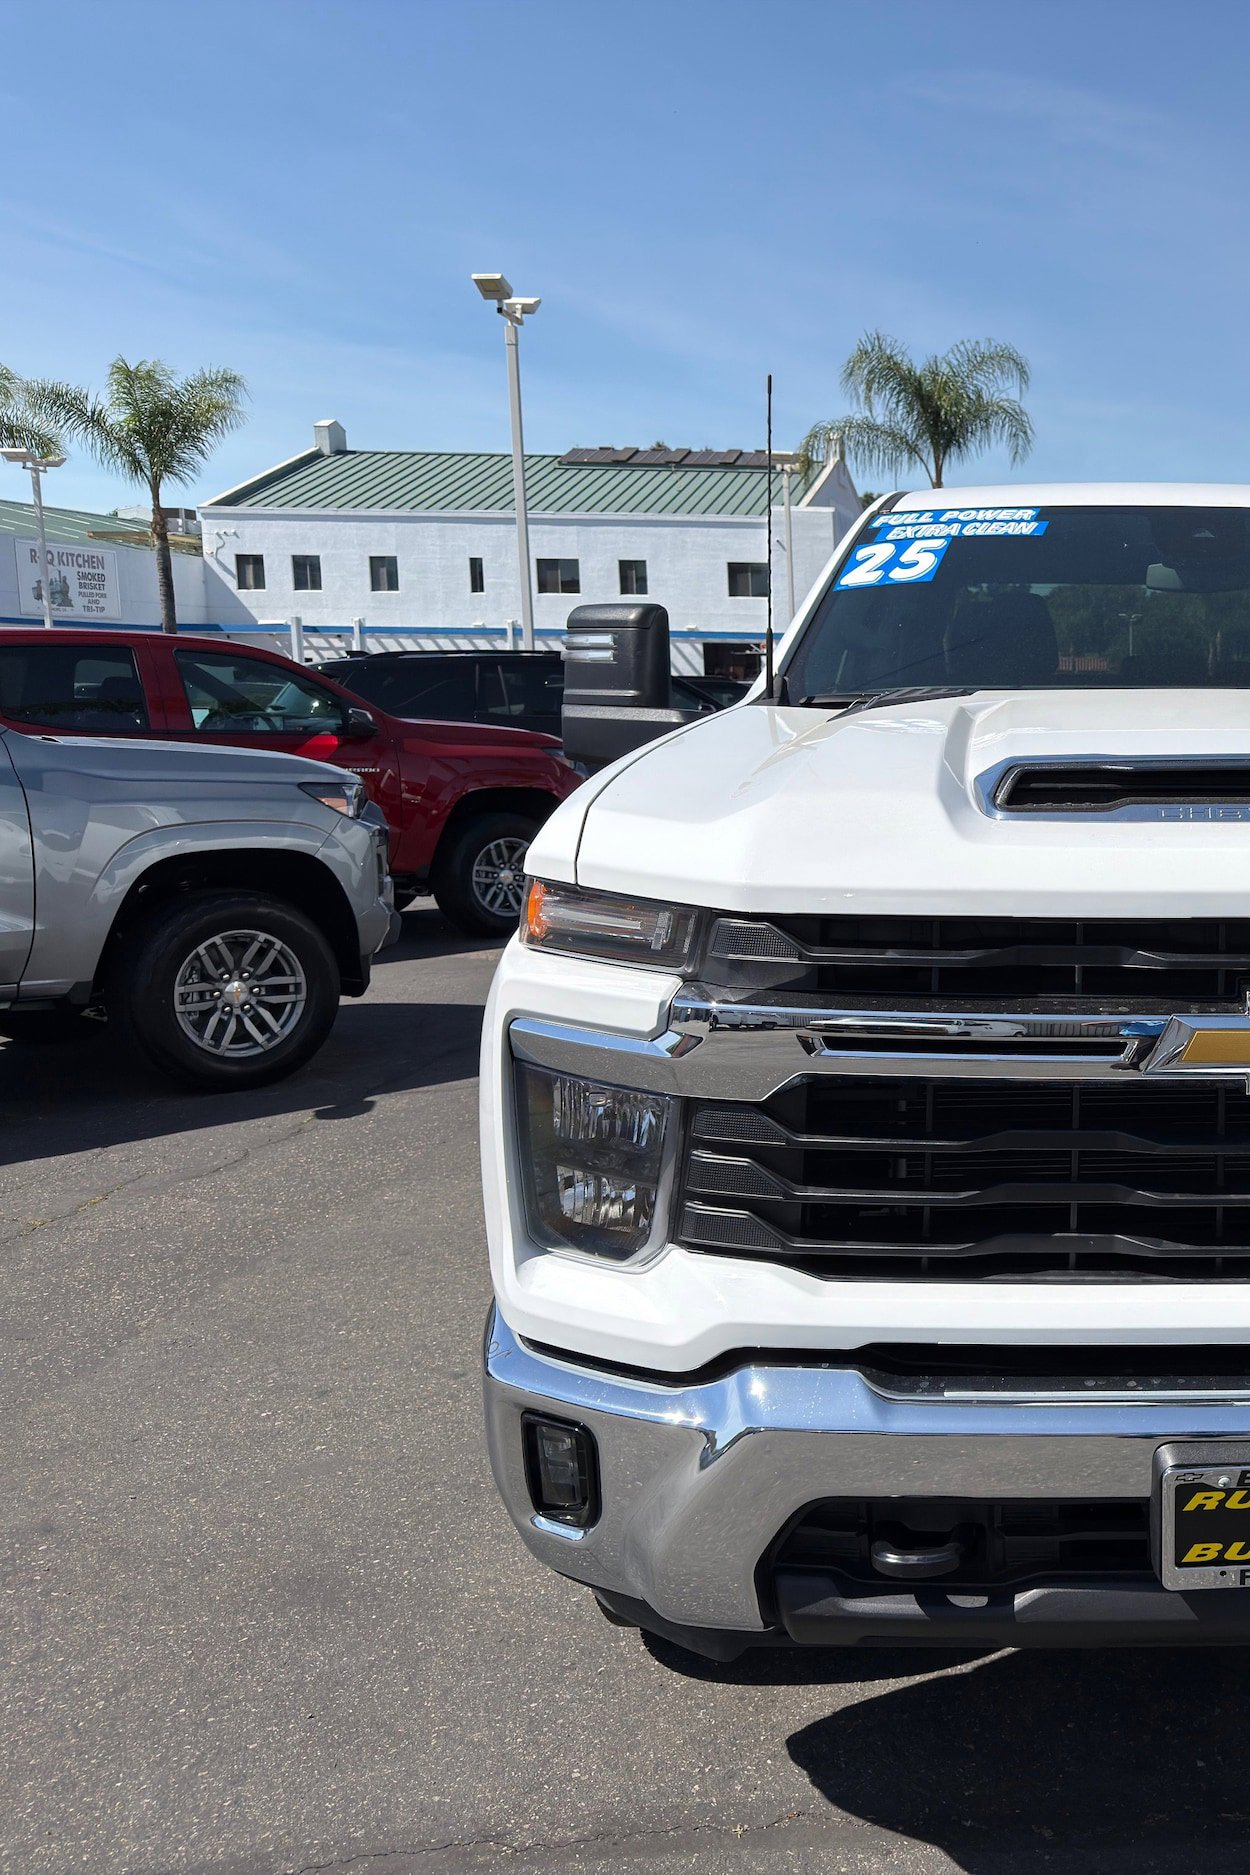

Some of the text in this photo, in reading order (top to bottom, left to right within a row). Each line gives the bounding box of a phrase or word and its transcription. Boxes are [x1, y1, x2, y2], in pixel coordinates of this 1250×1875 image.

[871, 508, 1036, 528] FULL POWER
[885, 521, 1039, 540] EXTRA CLEAN
[57, 551, 105, 570] KITCHEN
[840, 538, 948, 586] 25
[77, 571, 106, 583] SMOKED
[78, 582, 105, 591] BRISKET
[78, 591, 95, 599] PULLED
[82, 605, 105, 613] TRI-TIP
